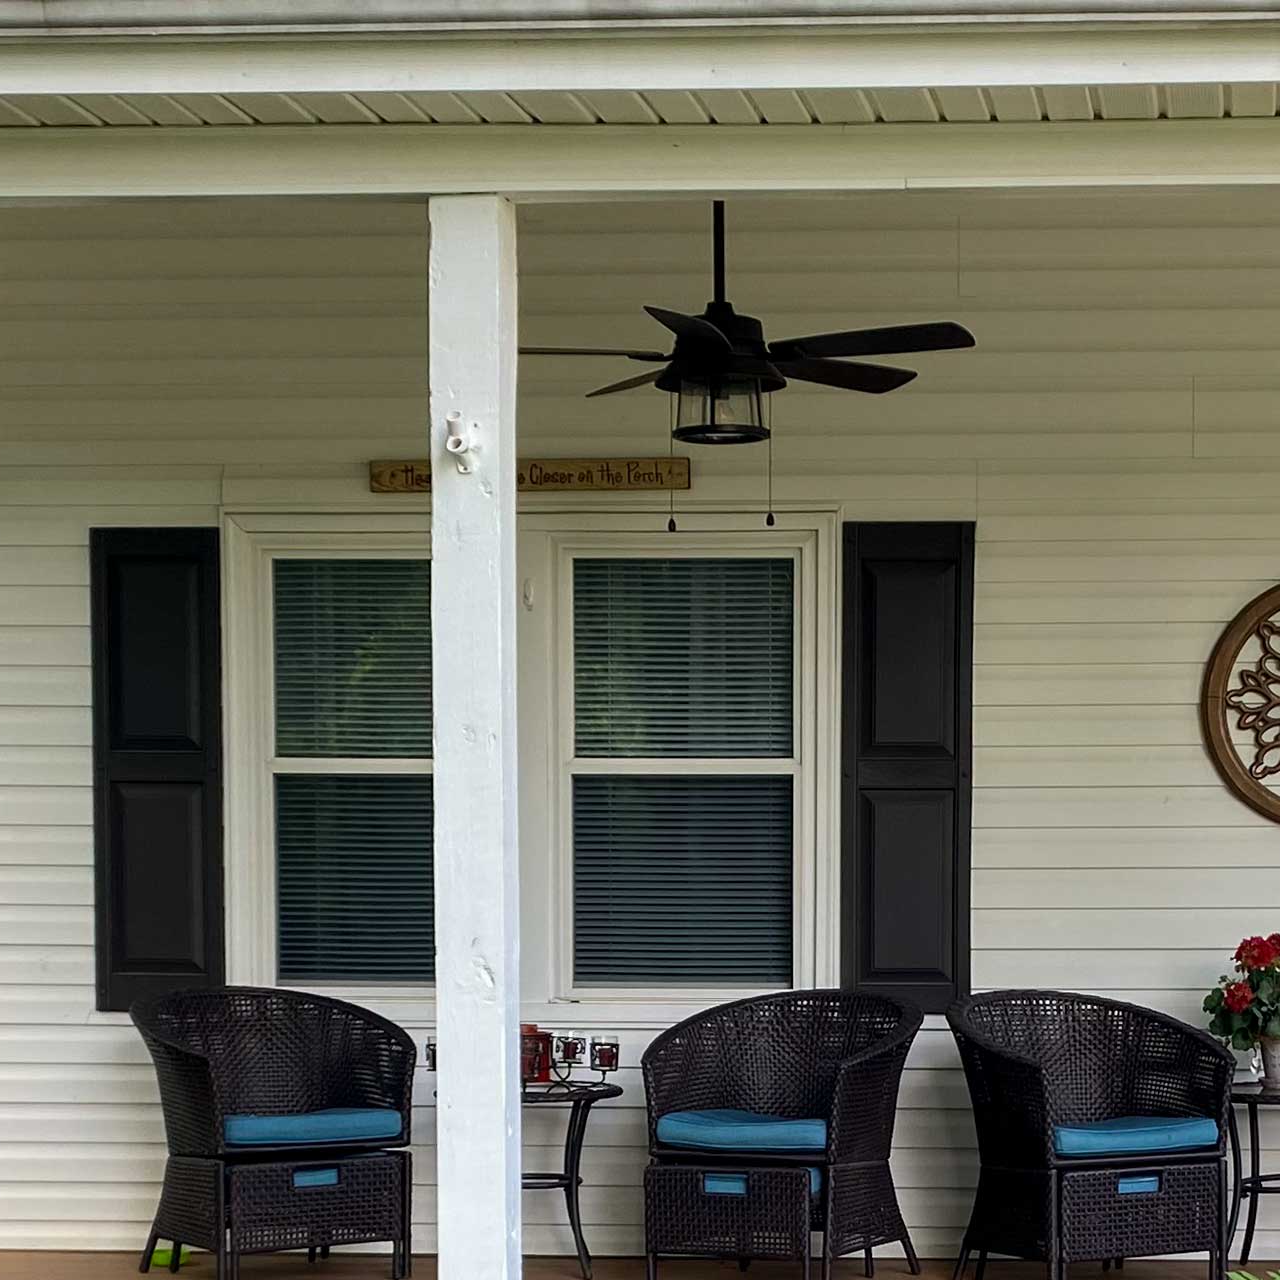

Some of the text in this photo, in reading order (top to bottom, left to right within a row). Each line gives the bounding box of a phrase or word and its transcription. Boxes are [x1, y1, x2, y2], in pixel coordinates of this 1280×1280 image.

[529, 463, 574, 486] Closer
[578, 470, 594, 485] on
[597, 462, 624, 486] the
[626, 460, 664, 485] Porch
